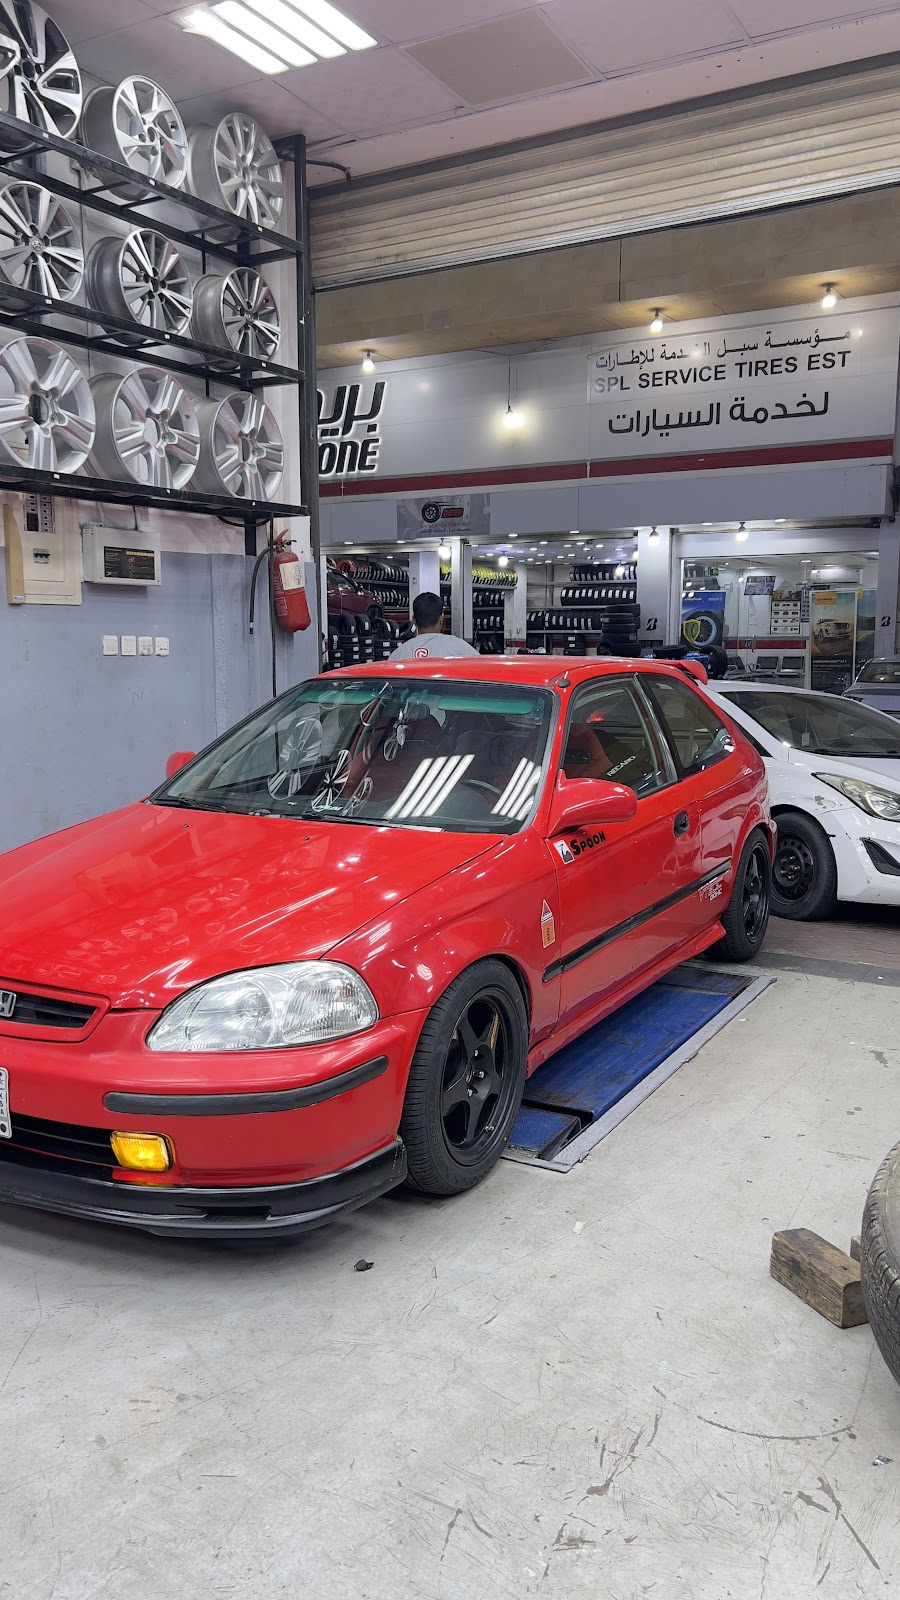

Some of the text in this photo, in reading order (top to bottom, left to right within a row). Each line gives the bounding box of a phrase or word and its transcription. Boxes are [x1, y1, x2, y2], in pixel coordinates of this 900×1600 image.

[716, 338, 759, 358] سبل
[594, 350, 851, 394] SPL SERVICE TIRES EST
[608, 391, 829, 437] لخدمة السيارات
[606, 755, 637, 777] RECARO
